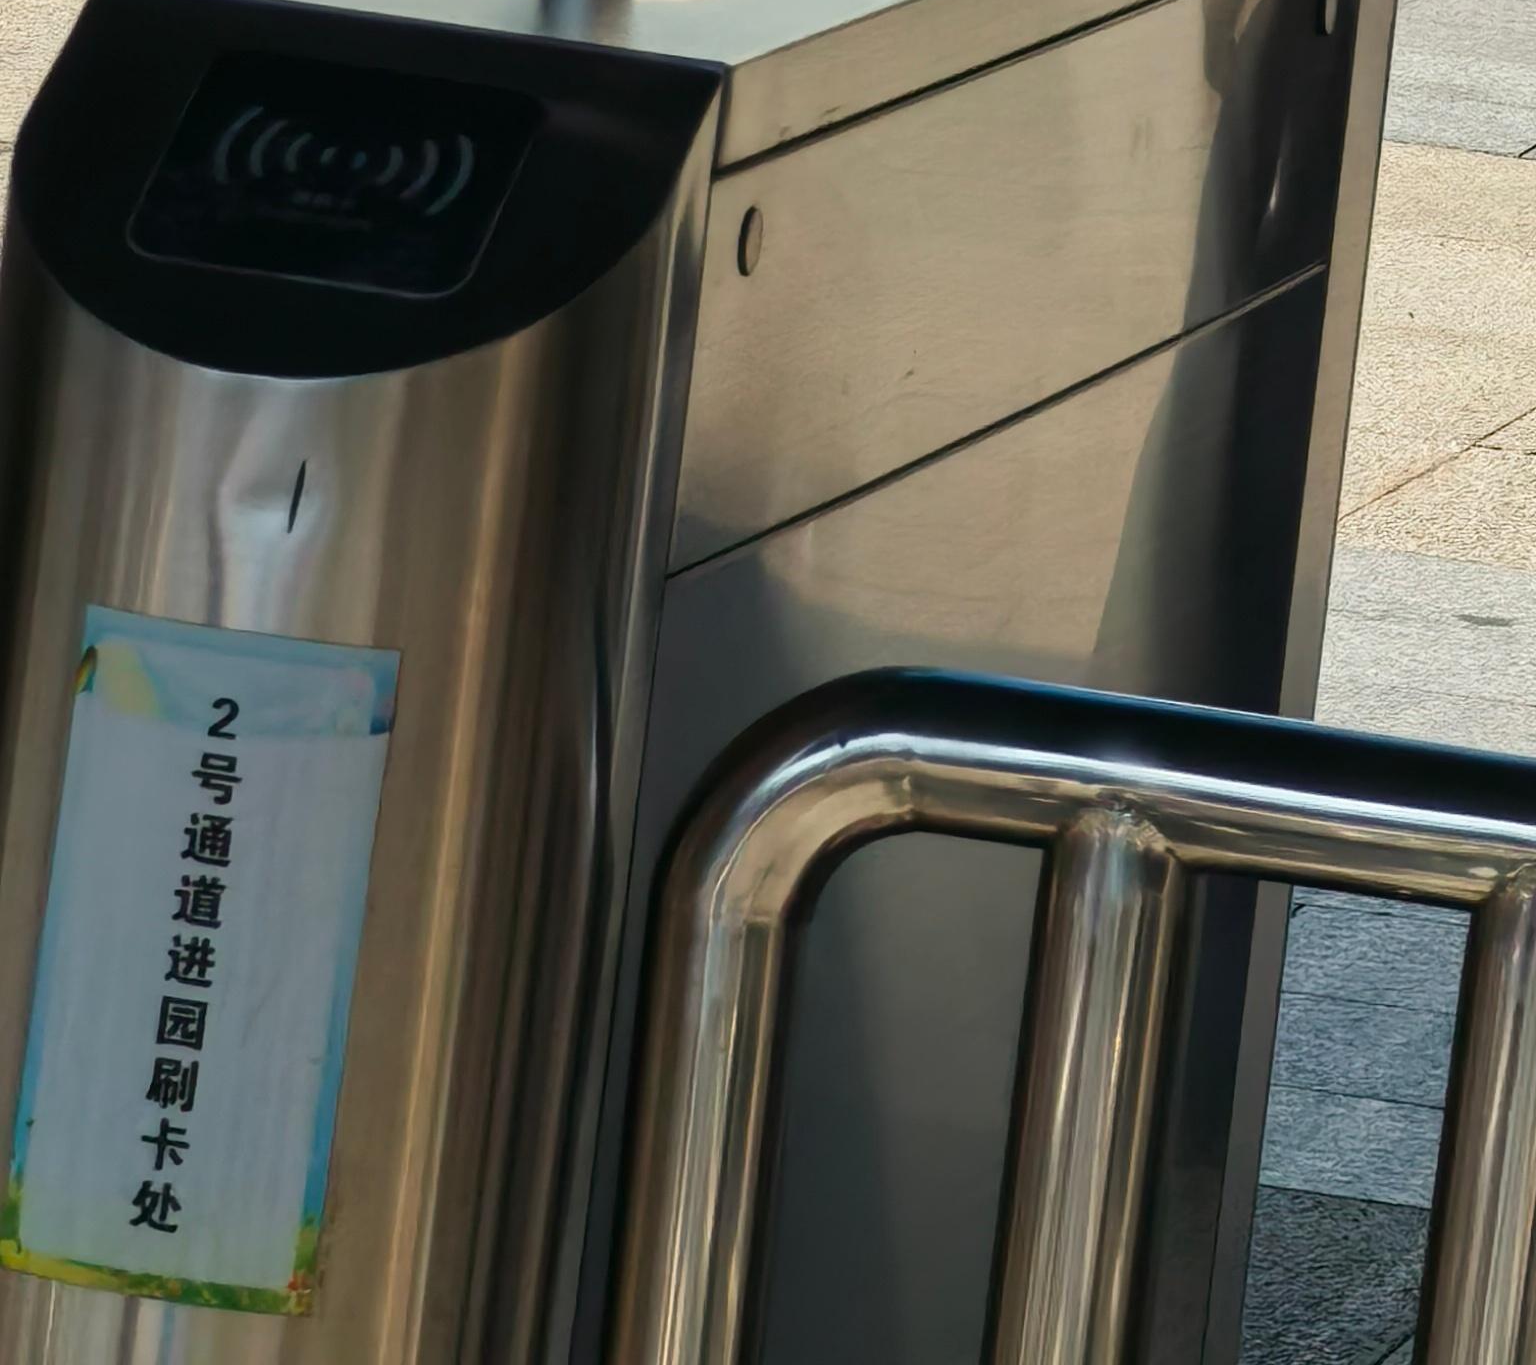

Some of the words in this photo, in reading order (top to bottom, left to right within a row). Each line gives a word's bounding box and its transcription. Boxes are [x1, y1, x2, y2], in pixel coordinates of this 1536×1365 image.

[128, 697, 242, 1234] 2号通道进园刷卡处
